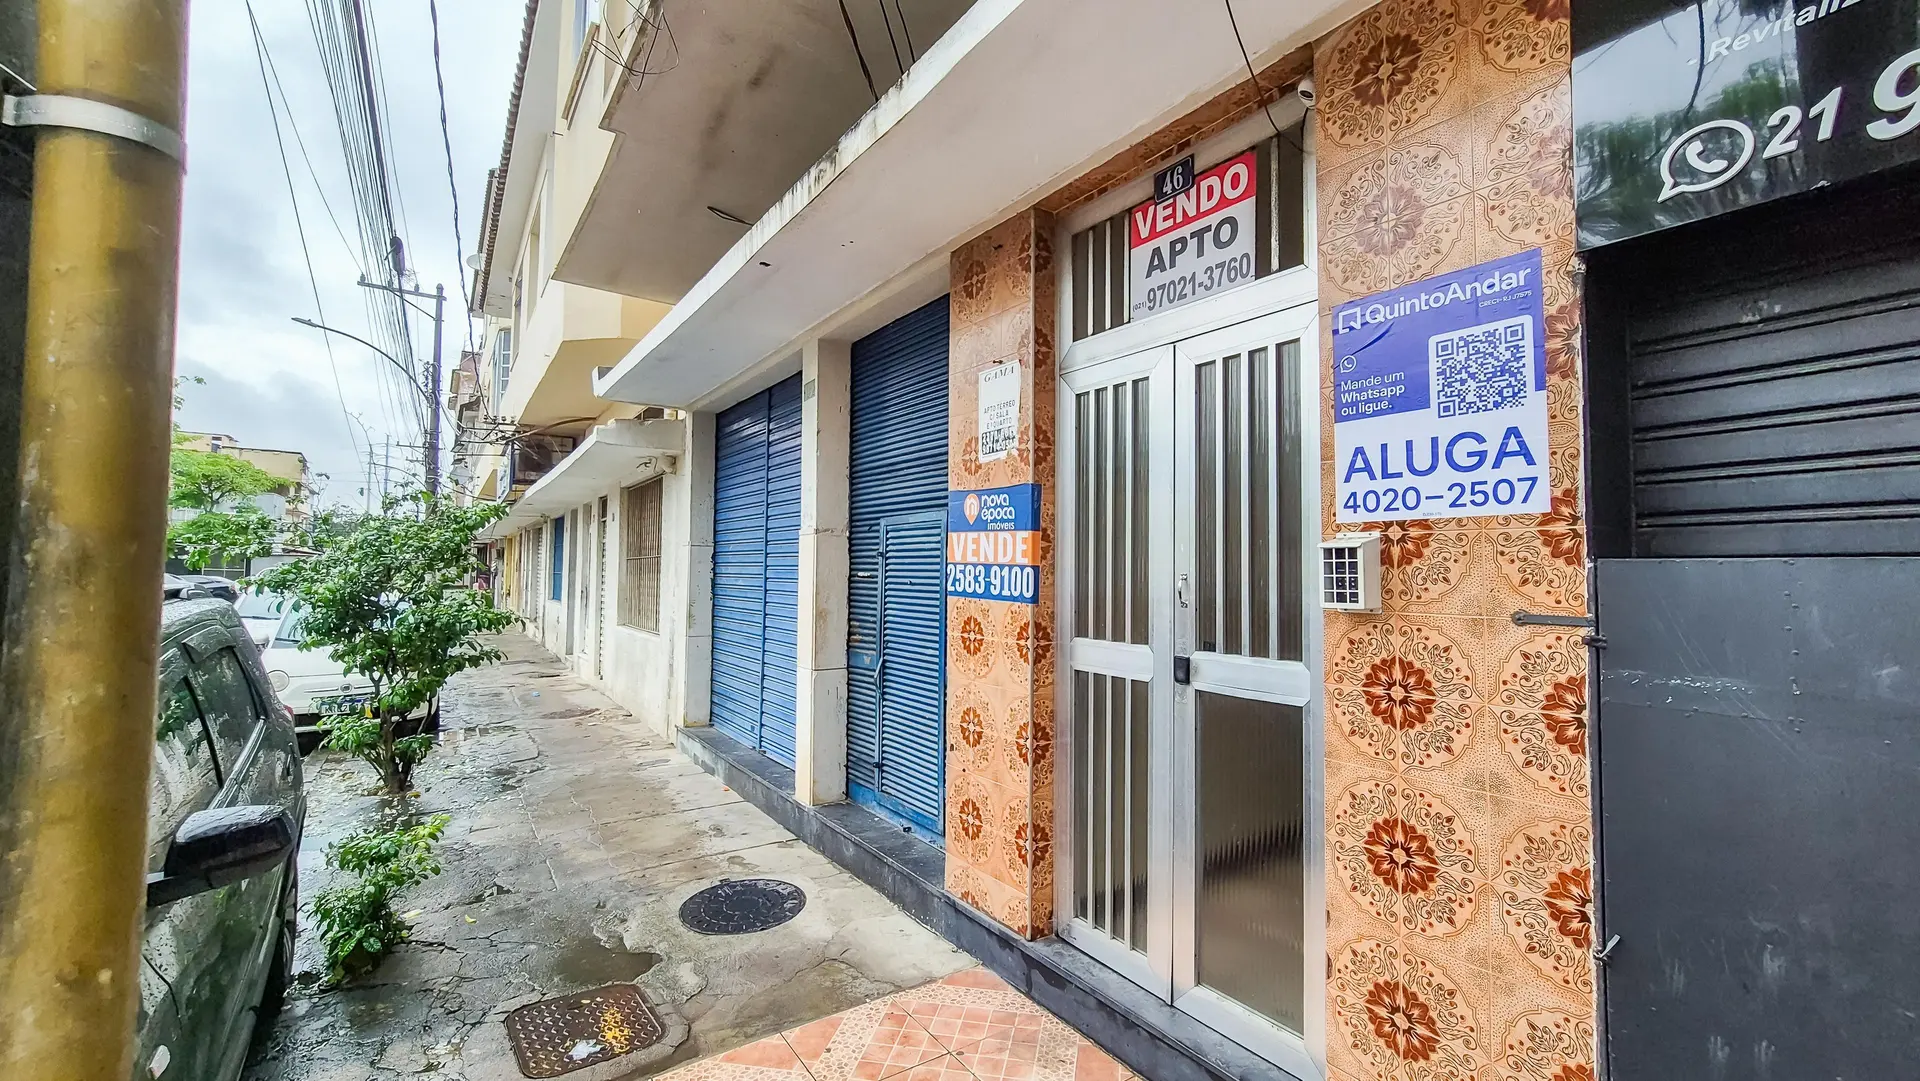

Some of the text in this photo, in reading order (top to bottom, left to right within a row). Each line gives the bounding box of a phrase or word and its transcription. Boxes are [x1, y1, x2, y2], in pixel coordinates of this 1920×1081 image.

[1762, 86, 1842, 160] 21
[1162, 165, 1184, 195] 46
[1135, 162, 1249, 240] VENDO
[1145, 215, 1239, 279] APTO
[1147, 252, 1251, 311] 97021-3760
[1365, 268, 1532, 324] QuintoAndar
[984, 365, 1014, 383] GAMA
[1341, 371, 1404, 391] Mande um
[1341, 384, 1405, 403] Whatsapp
[1341, 400, 1393, 416] ou ligue.
[1343, 426, 1537, 483] ALUGA
[981, 493, 1009, 507] nova
[1343, 476, 1539, 514] 4020-2507
[981, 506, 1015, 522] época
[987, 521, 1015, 530] imóveis
[952, 531, 1029, 564] VENDE
[947, 564, 1035, 598] 2583-9100
